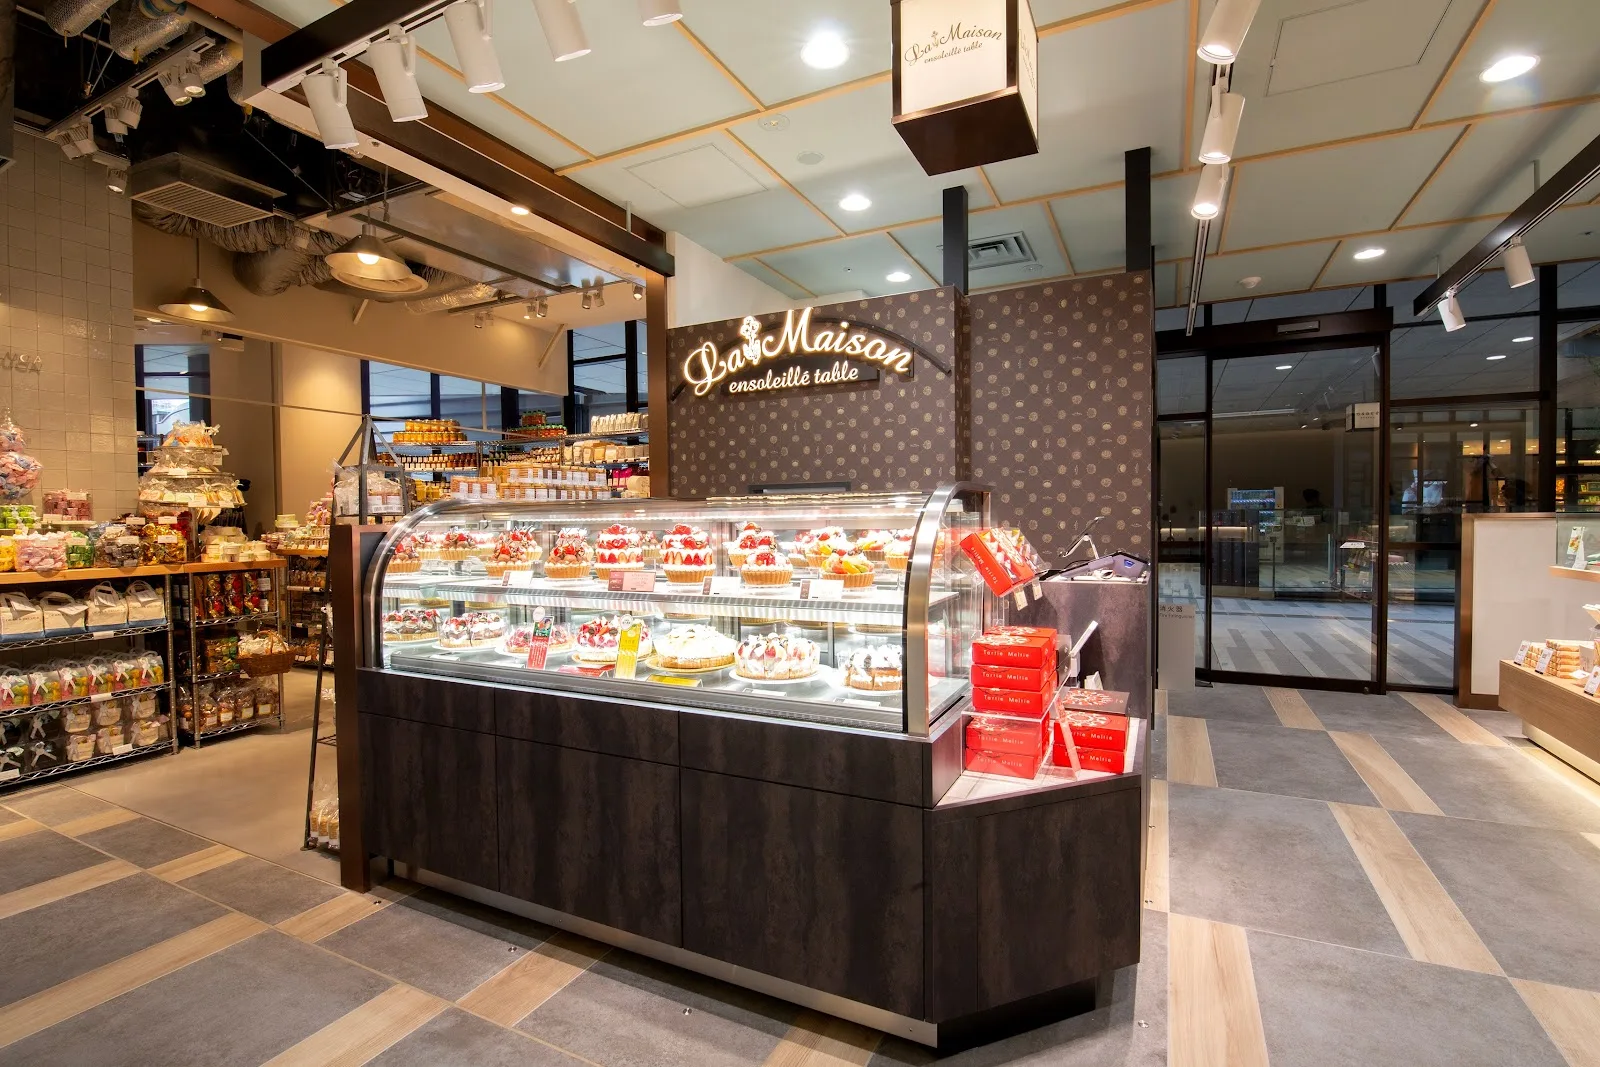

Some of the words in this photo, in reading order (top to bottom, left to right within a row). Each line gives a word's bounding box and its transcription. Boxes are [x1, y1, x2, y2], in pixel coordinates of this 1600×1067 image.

[904, 43, 932, 66] La
[939, 22, 1003, 44] Maison
[963, 41, 983, 53] table
[684, 341, 746, 397] La
[760, 306, 914, 373] Maison
[814, 360, 860, 388] table
